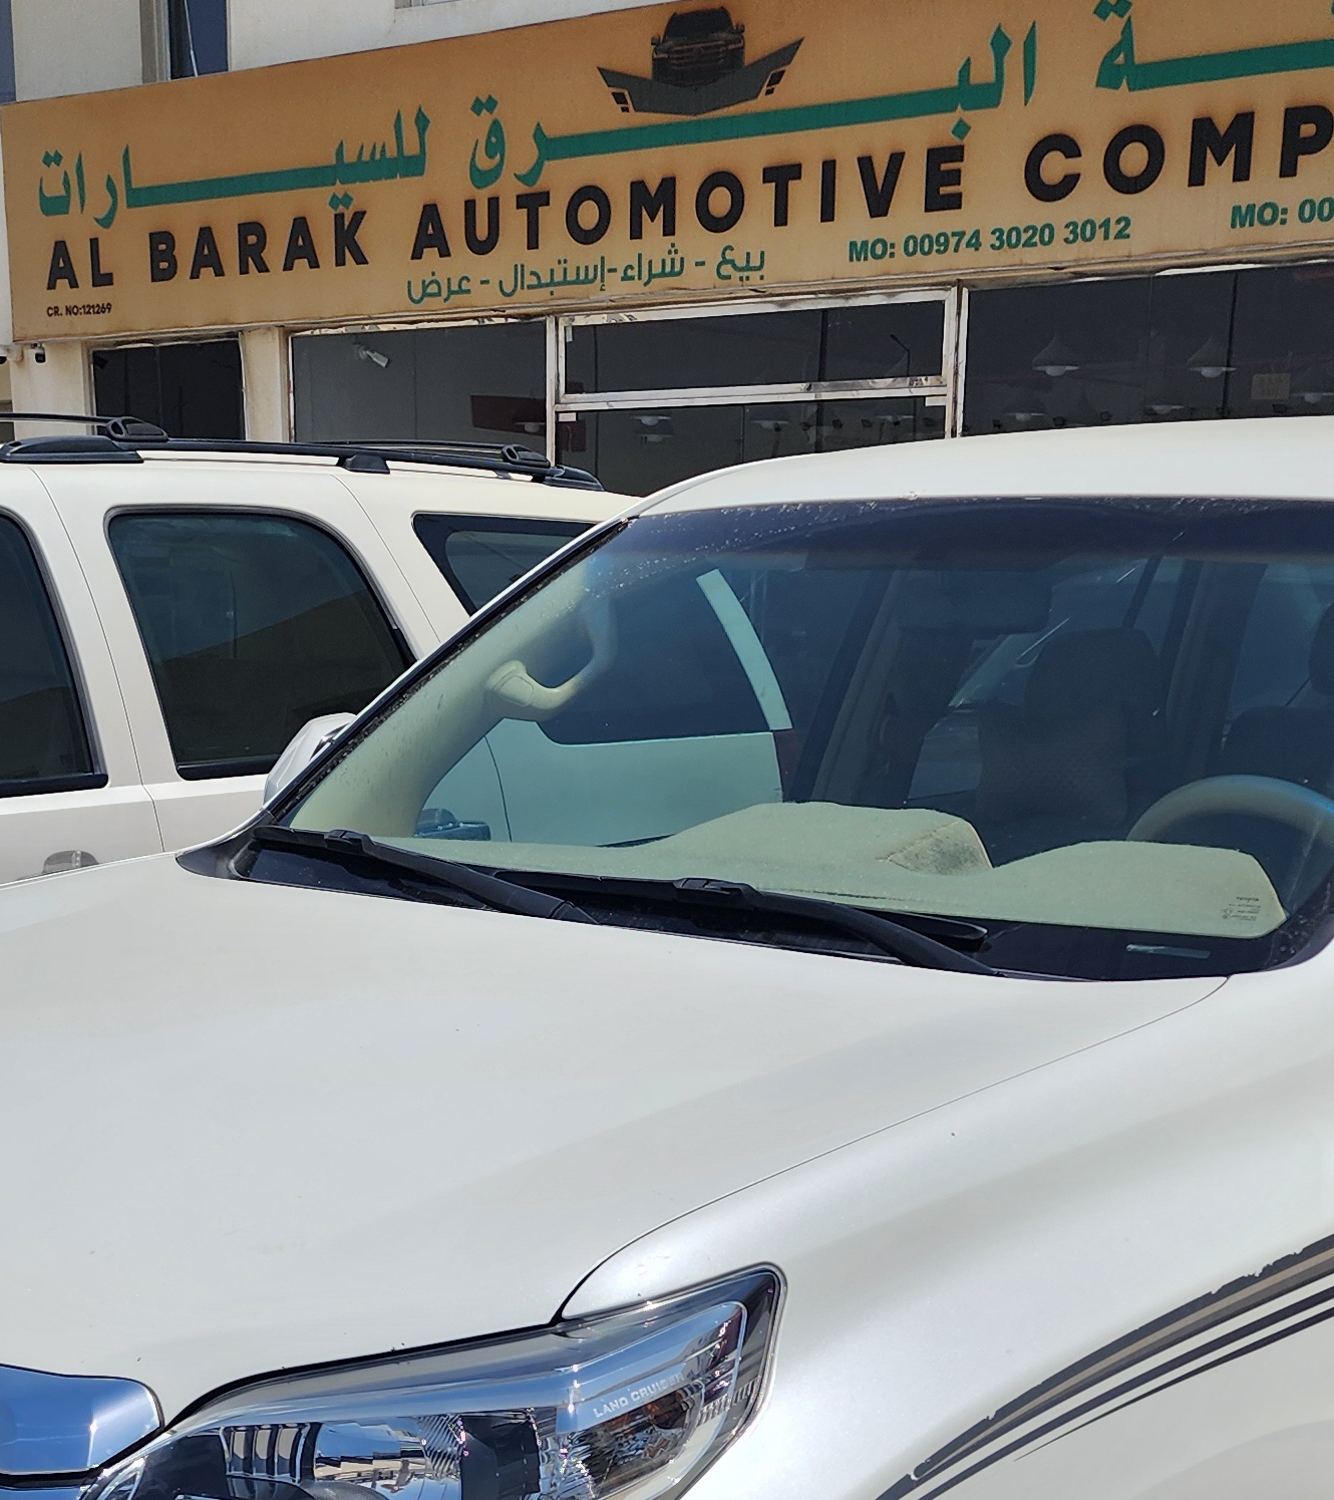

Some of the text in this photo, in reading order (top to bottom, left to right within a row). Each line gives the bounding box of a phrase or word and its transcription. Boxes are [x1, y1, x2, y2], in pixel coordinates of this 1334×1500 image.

[469, 20, 1037, 190] البرق
[39, 105, 430, 230] للسيارات
[47, 237, 114, 291] AL
[149, 210, 369, 283] BARAK
[410, 145, 965, 260] AUTOMOTIVE
[1229, 201, 1288, 229] MO:
[848, 216, 1132, 263] MO: 00974 3020 3012
[715, 244, 766, 283] بيع
[65, 302, 113, 316] NO:121269
[406, 271, 471, 305] عرض
[593, 1373, 684, 1418] LAND CRUISER
